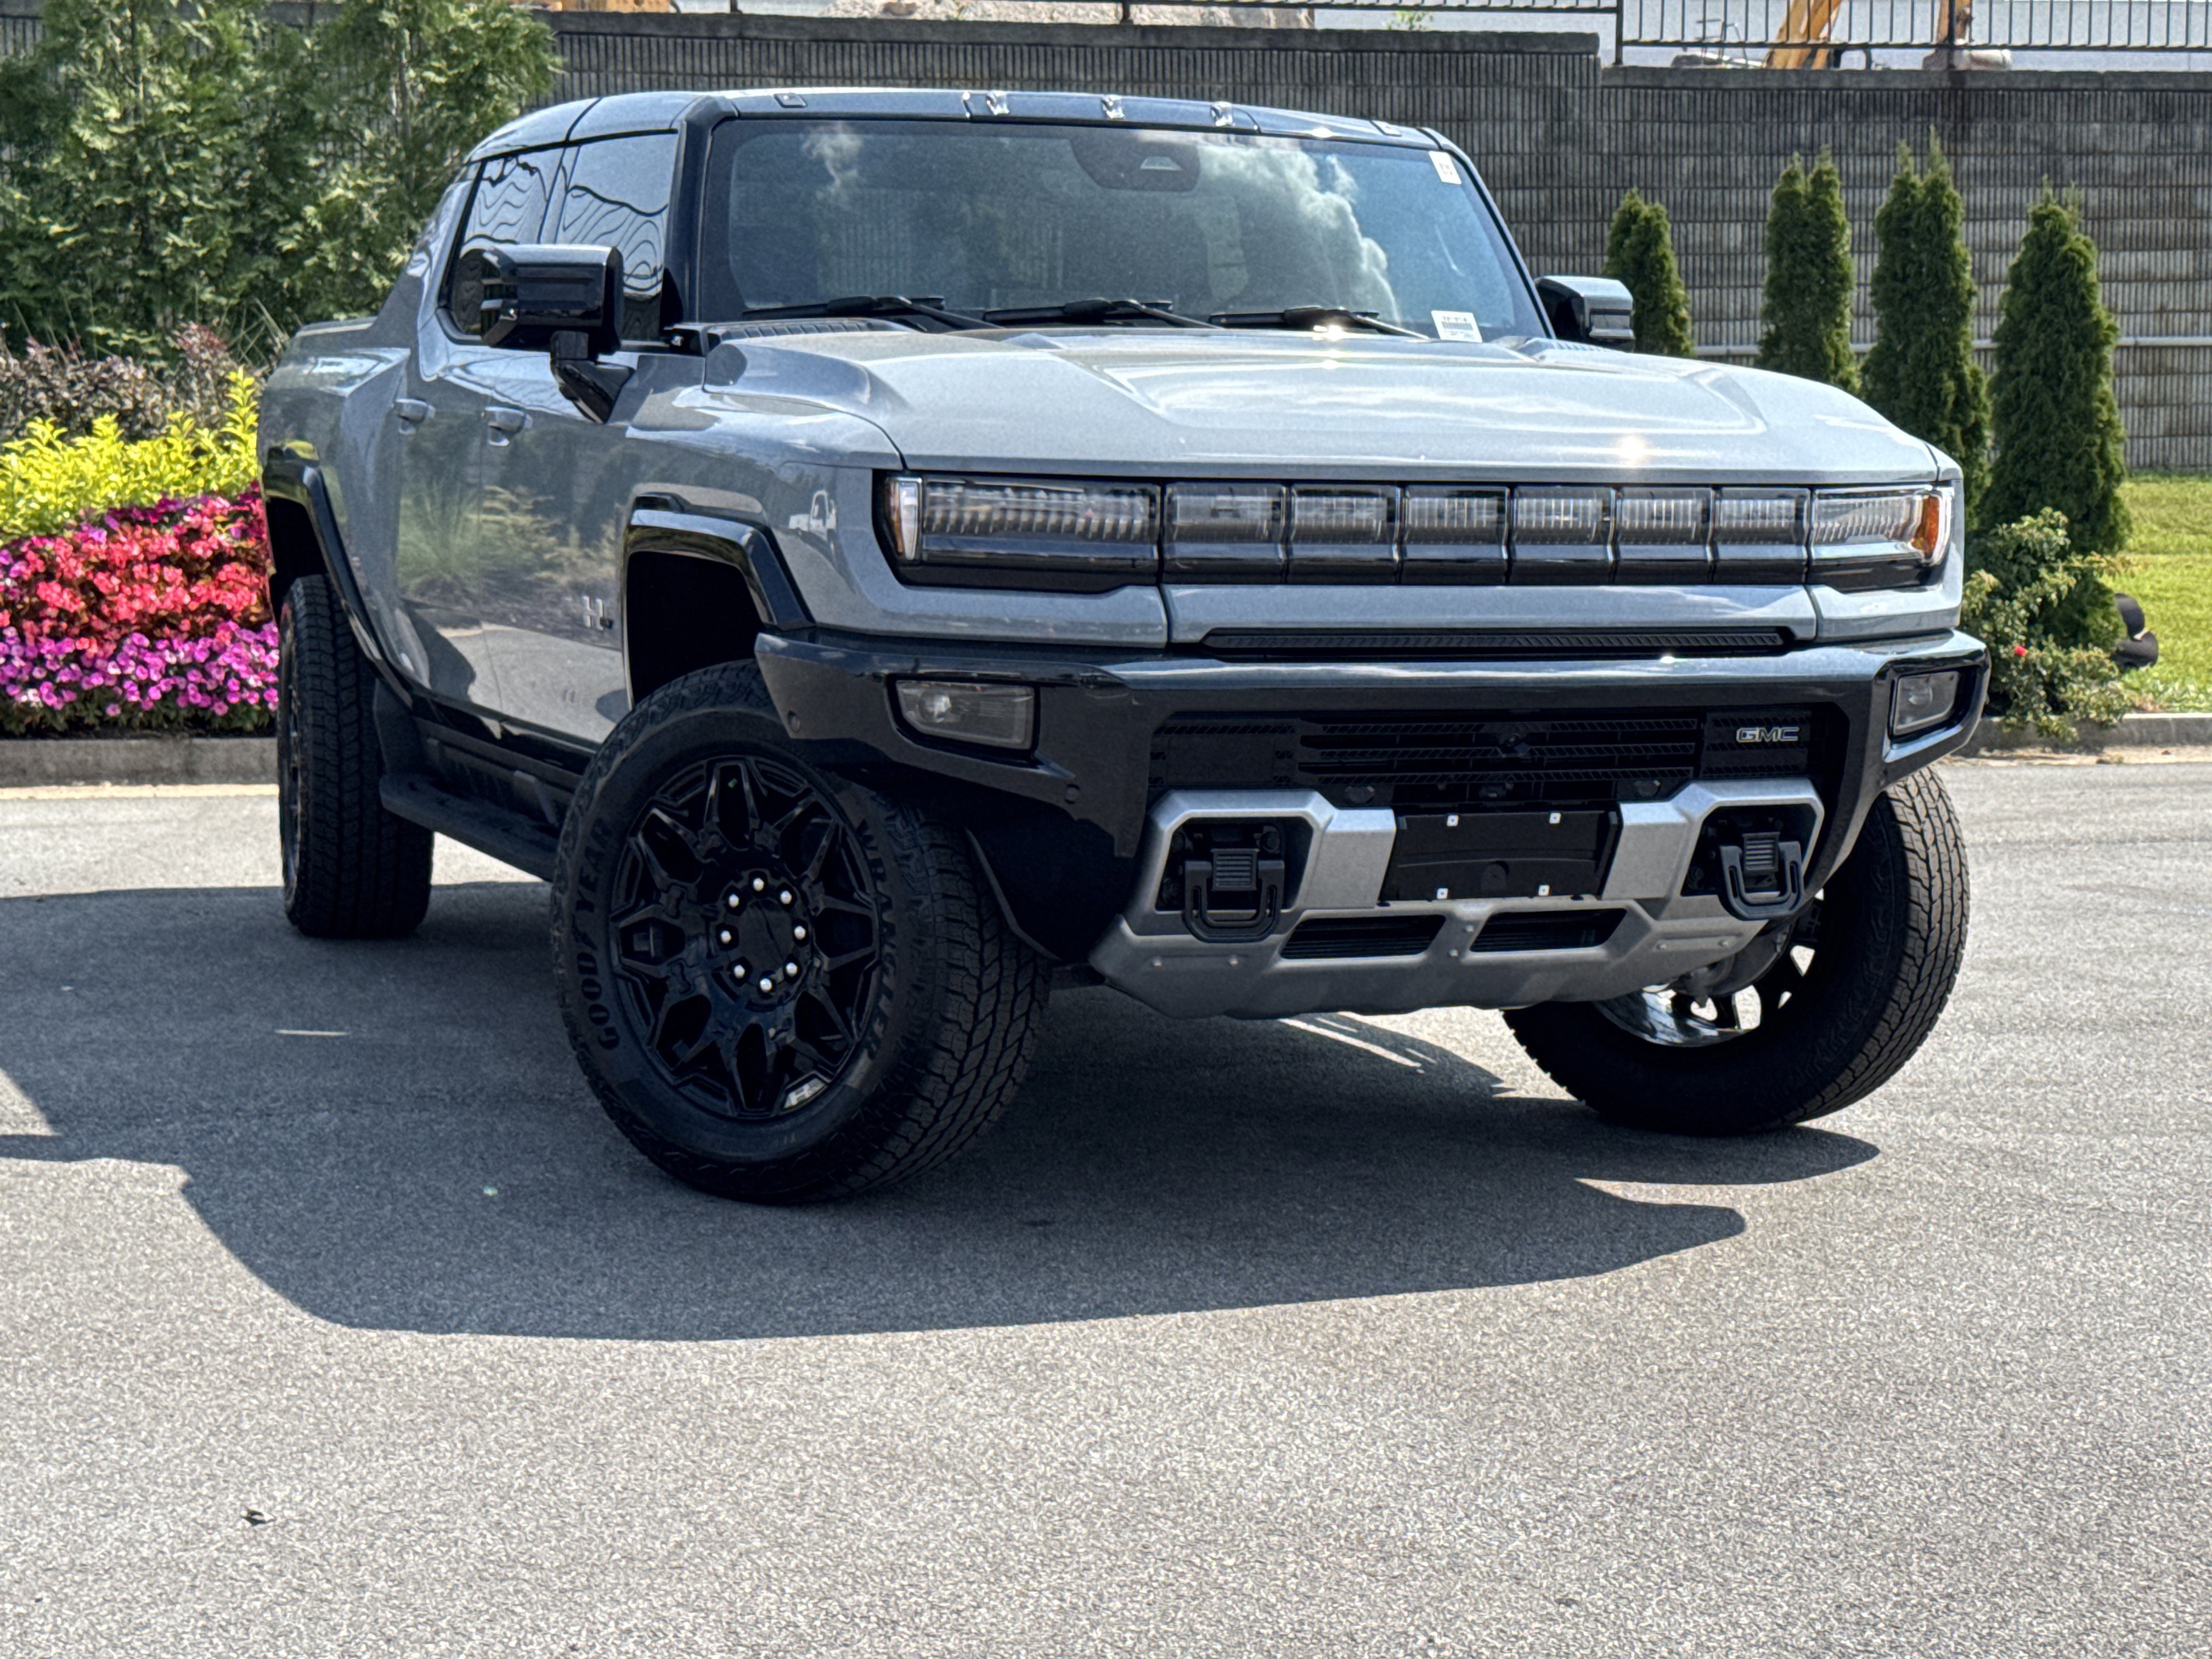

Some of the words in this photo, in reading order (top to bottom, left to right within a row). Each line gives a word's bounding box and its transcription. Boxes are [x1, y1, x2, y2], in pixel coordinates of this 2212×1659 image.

[1736, 726, 1800, 743] GMC
[572, 817, 620, 1050] GOODYEAR
[857, 819, 896, 1060] WRANGLER
